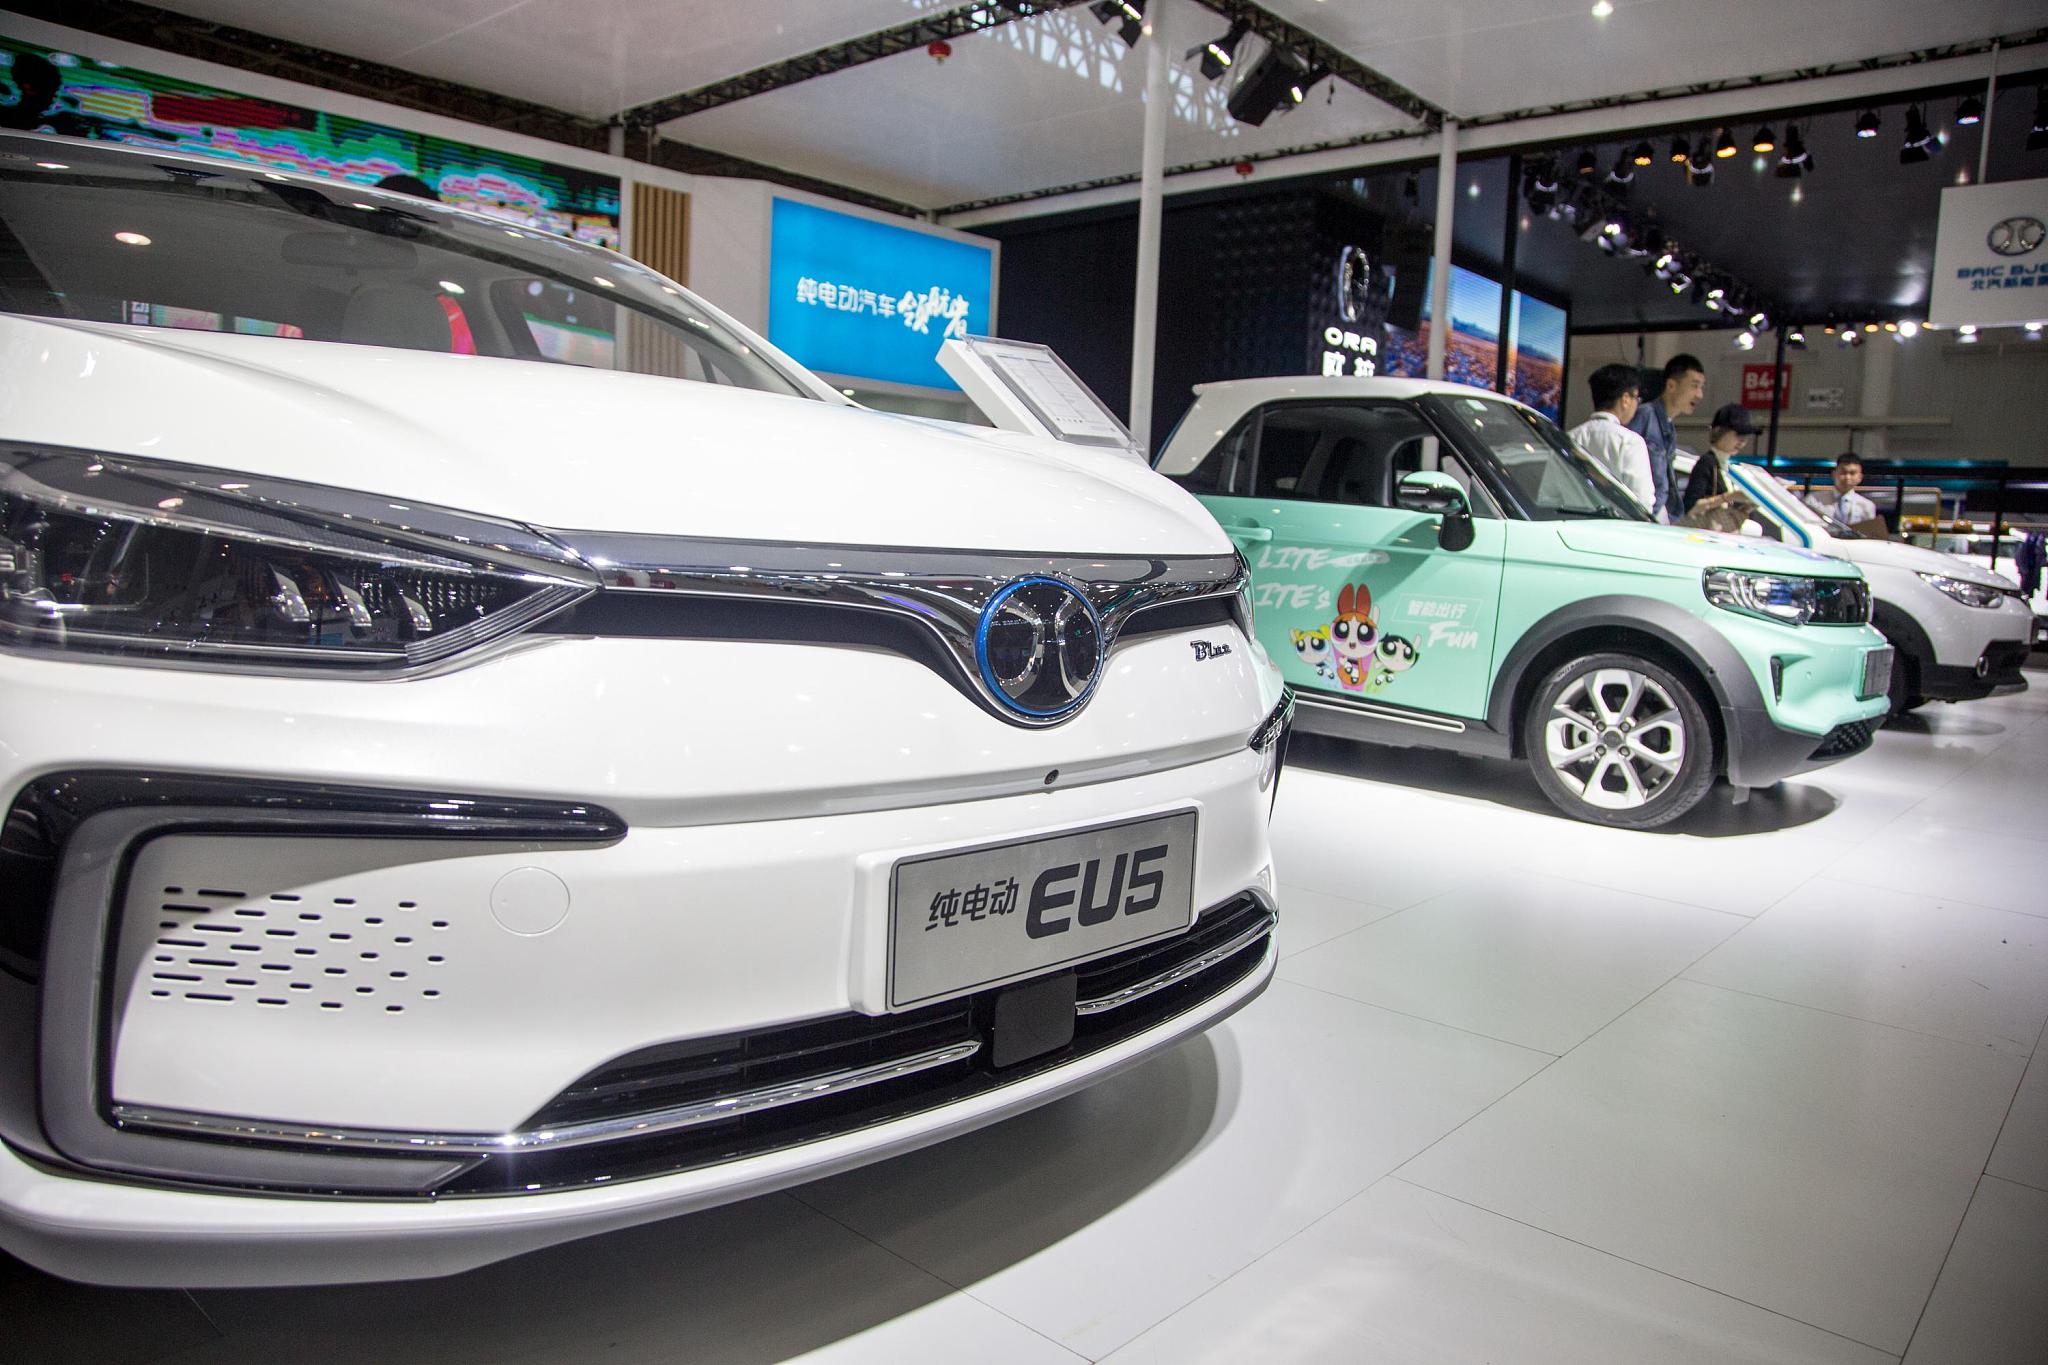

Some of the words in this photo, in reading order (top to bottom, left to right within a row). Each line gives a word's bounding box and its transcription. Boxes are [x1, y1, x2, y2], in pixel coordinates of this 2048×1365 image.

[1957, 265, 2004, 278] BAIC
[1324, 326, 1377, 356] ORA
[1257, 544, 1332, 571] LITE
[1427, 620, 1479, 649] Fun
[1190, 639, 1232, 661] Blue
[925, 876, 1020, 932] 纯电动
[1025, 844, 1169, 940] EU5
